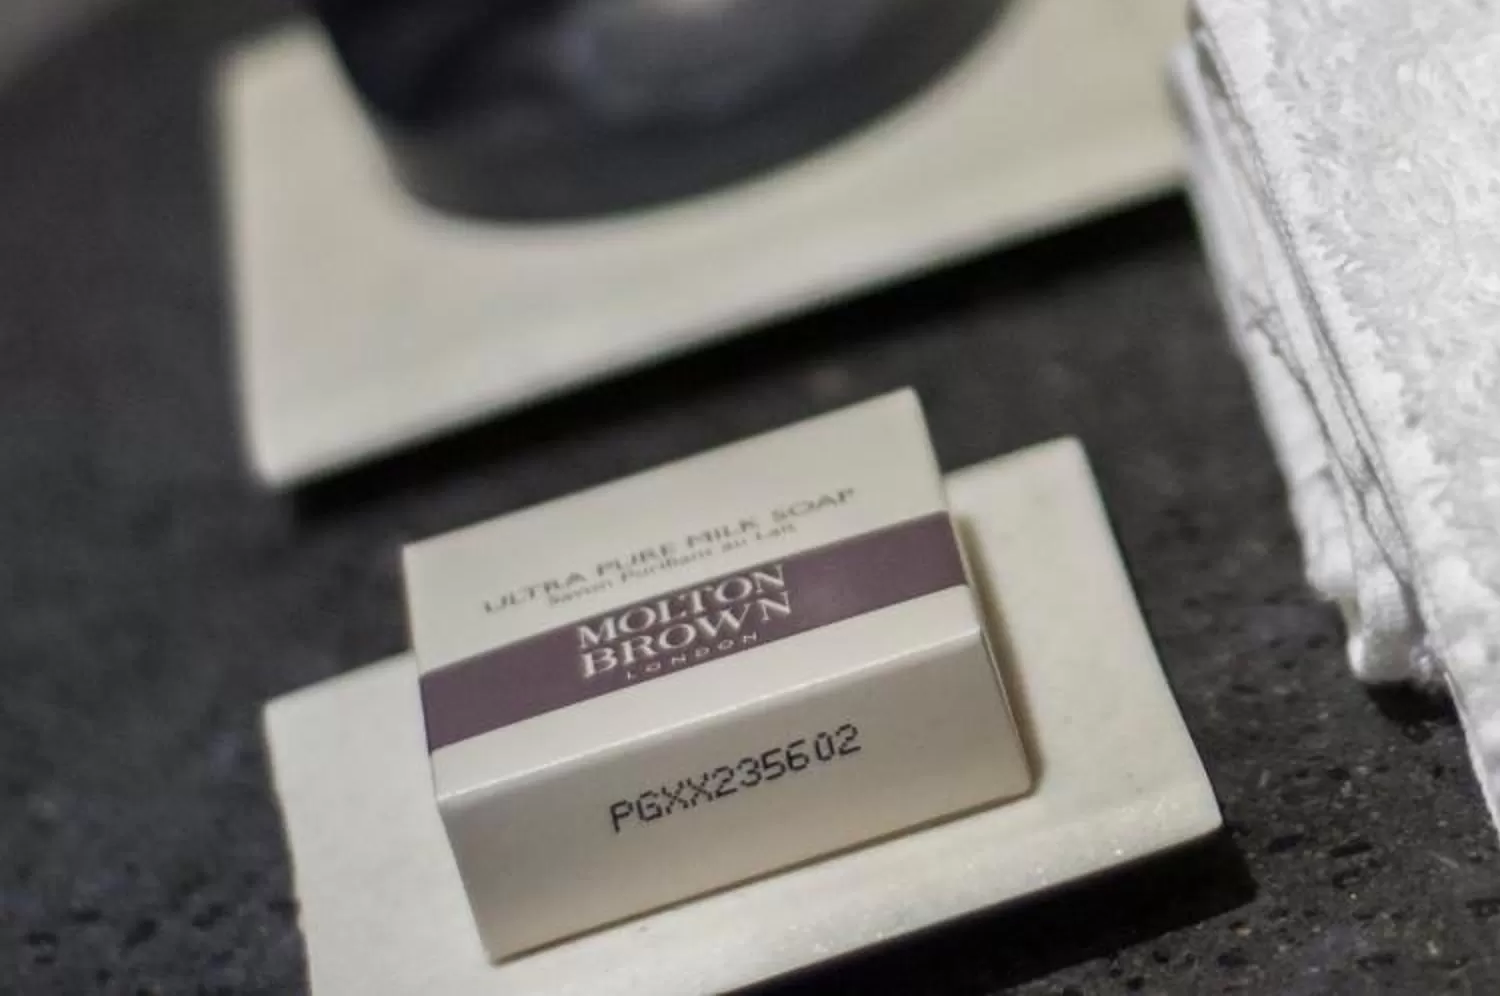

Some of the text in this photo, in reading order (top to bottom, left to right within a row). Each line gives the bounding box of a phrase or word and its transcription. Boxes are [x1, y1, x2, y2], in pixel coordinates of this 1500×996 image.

[483, 487, 855, 614] ULTRA PURE MILK SOAP
[577, 564, 785, 649] MOLTON
[579, 591, 792, 679] BROWN
[627, 632, 758, 681] LONDON
